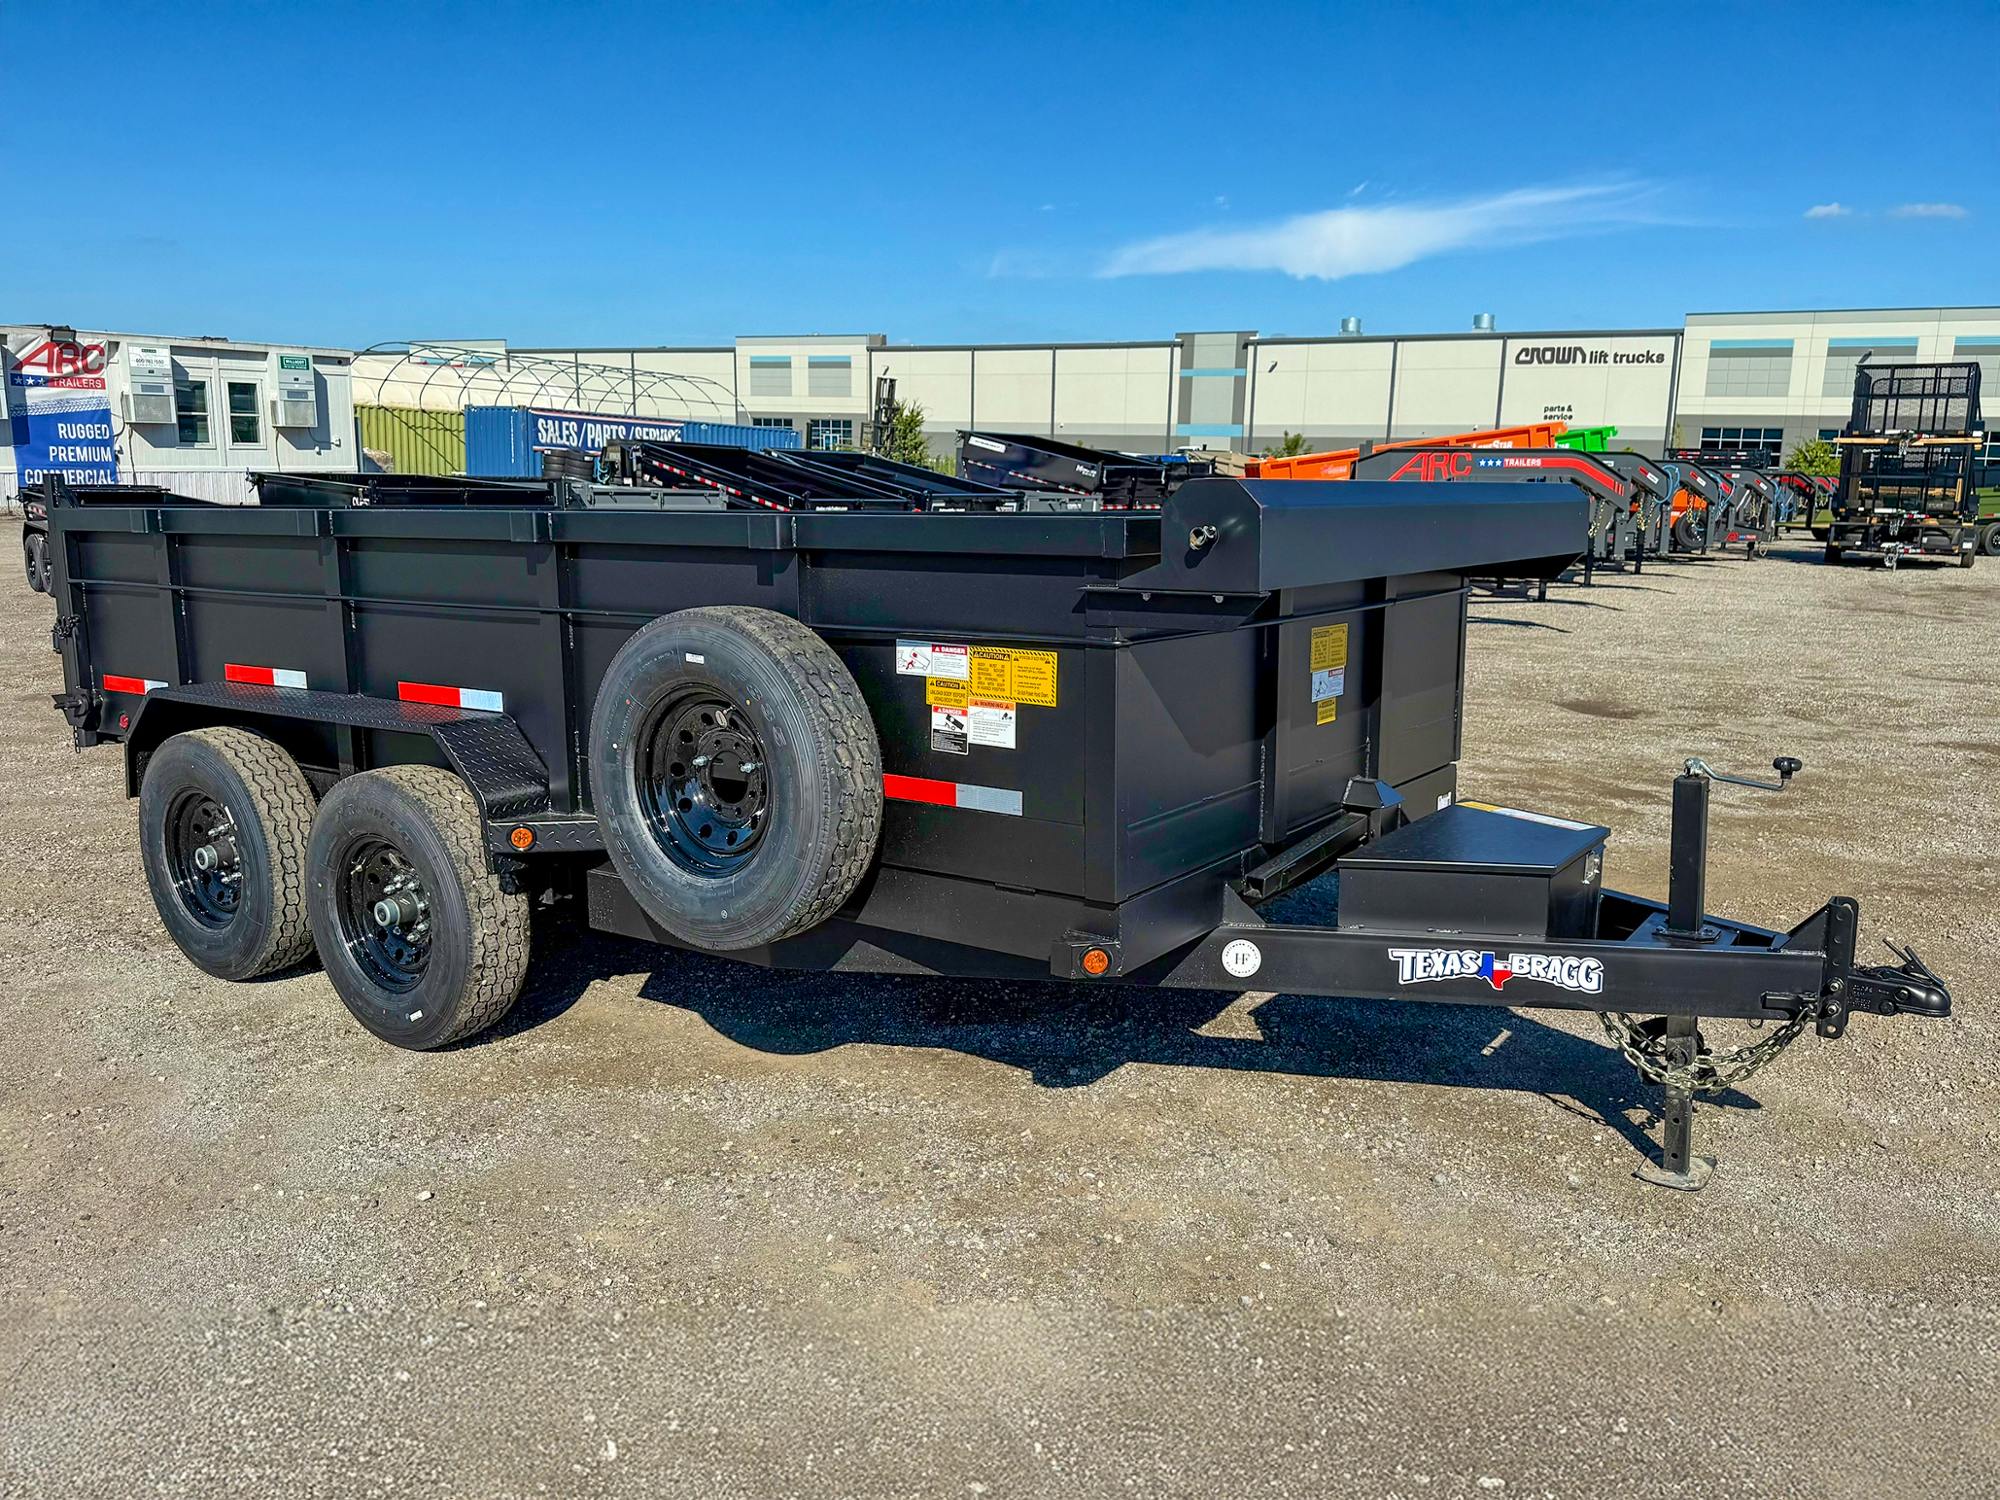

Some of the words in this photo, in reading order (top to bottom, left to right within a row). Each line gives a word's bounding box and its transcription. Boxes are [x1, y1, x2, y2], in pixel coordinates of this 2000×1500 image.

[11, 341, 105, 374] ARC
[1515, 346, 1586, 365] CROWN
[1589, 350, 1609, 364] lift
[1613, 349, 1665, 364] trucks
[53, 379, 102, 388] TRAILERS
[1544, 405, 1565, 413] parts
[58, 423, 110, 439] RUGGED
[49, 446, 112, 462] PREMIUM
[1389, 452, 1472, 481] ARC
[1504, 458, 1542, 467] TRAILERS
[25, 469, 115, 485] COERCIAL
[936, 681, 959, 689] CAUTION
[1391, 950, 1481, 982] TEXAS
[1510, 954, 1602, 992] BRAGG
